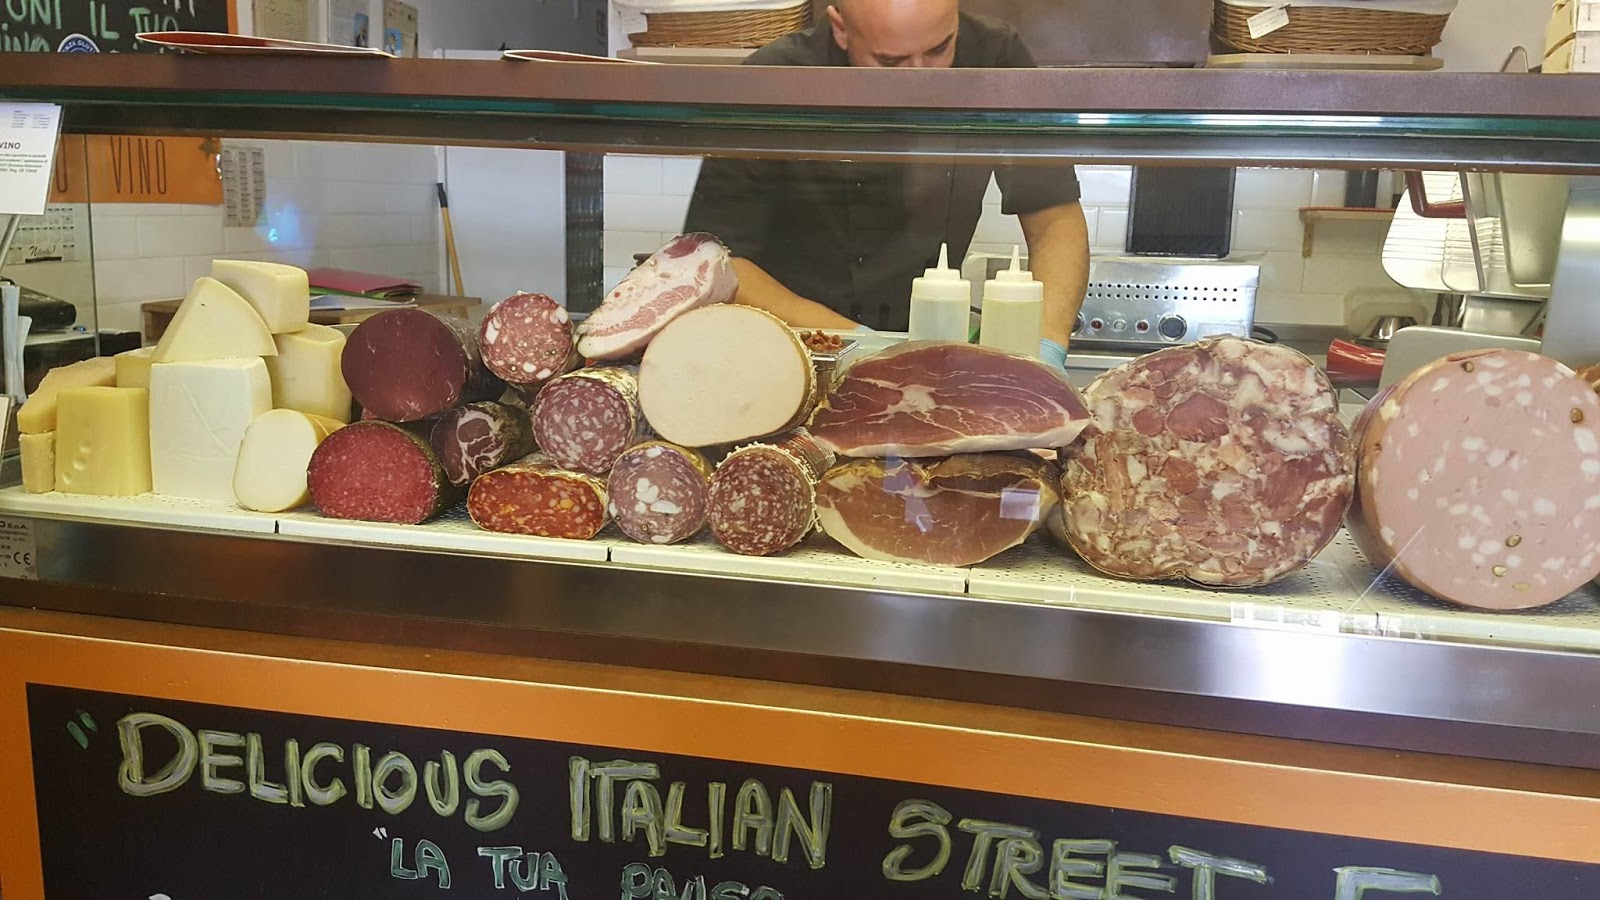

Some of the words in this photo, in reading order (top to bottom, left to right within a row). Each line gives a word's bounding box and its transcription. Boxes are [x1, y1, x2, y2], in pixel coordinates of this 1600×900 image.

[89, 0, 120, 39] IL
[110, 135, 167, 195] VINO
[568, 755, 833, 869] ITALIAN
[882, 798, 1275, 900] STREET
[477, 845, 569, 900] TUA
[621, 867, 785, 900] PAU
